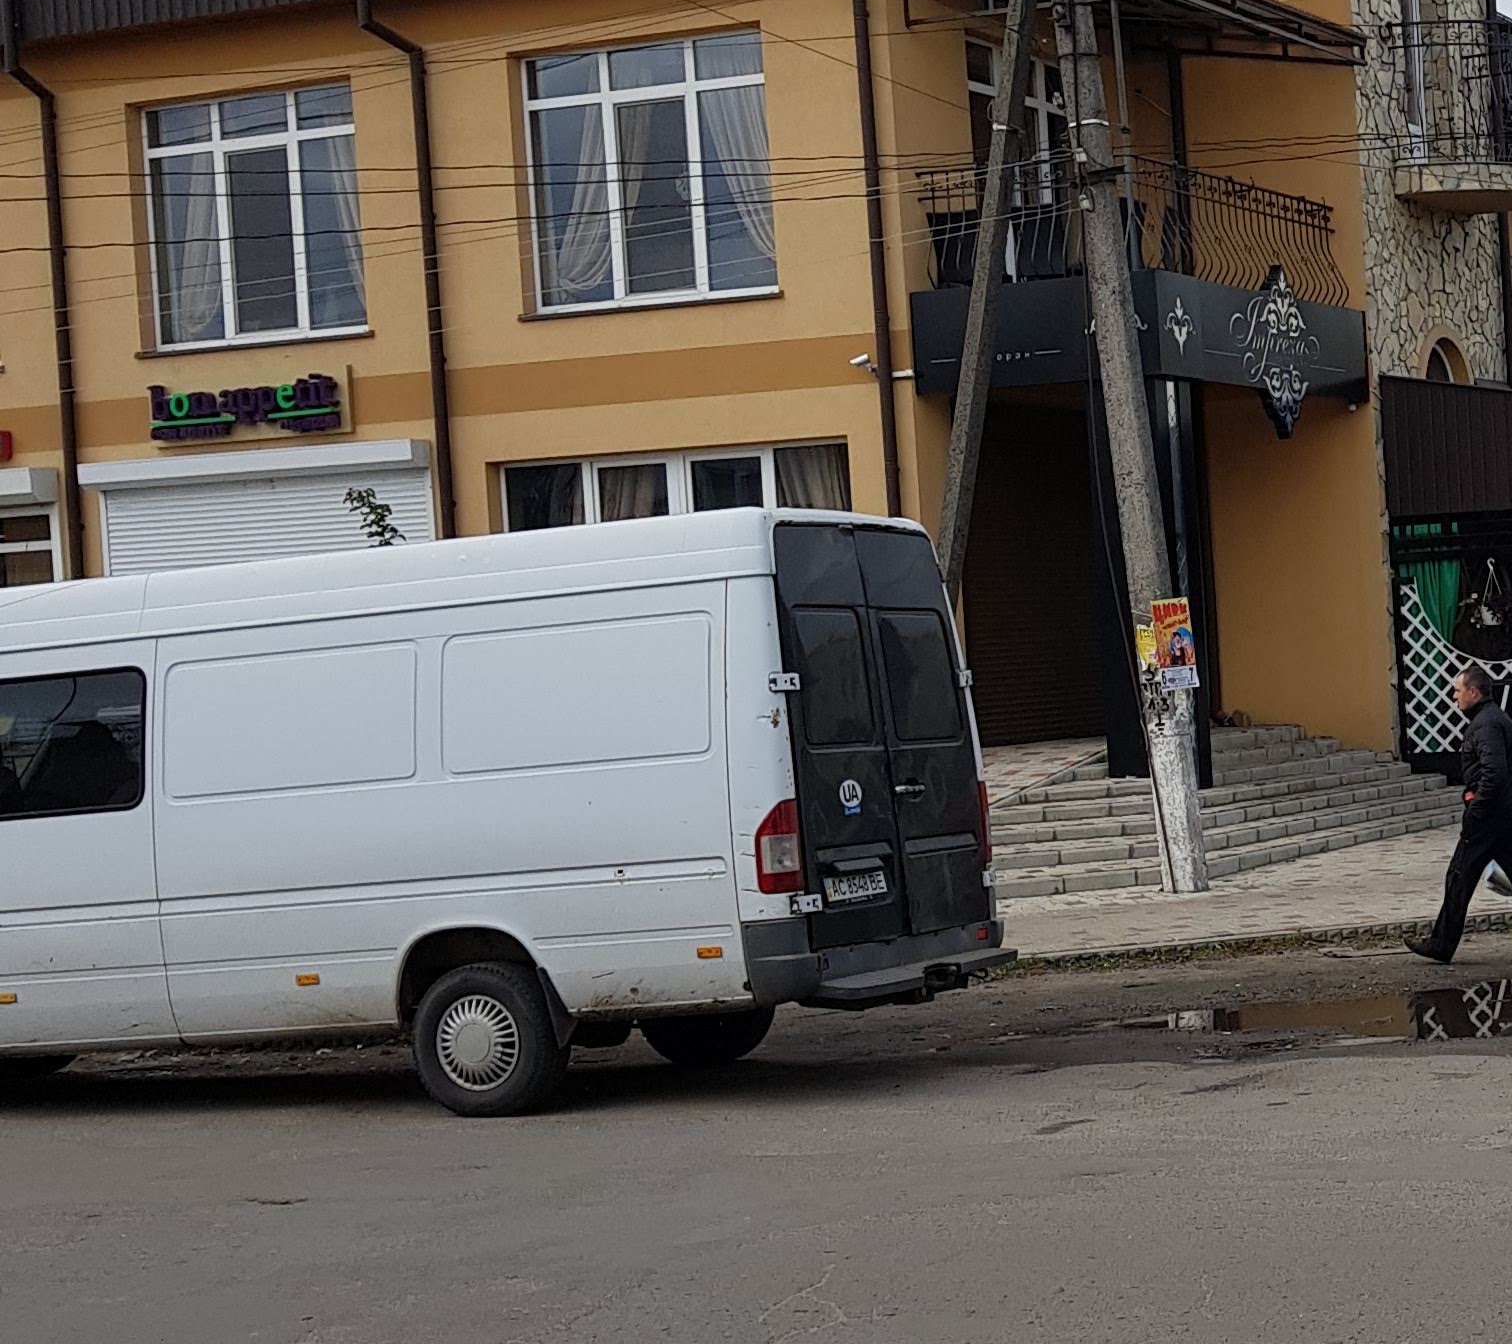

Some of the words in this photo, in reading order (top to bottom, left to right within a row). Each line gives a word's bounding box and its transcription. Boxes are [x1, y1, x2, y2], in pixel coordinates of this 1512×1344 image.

[147, 385, 221, 421] bon
[218, 373, 341, 425] appetit
[1161, 670, 1168, 686] 6
[1188, 667, 1194, 682] 7
[842, 783, 860, 804] UA
[832, 878, 847, 897] AC
[868, 872, 885, 892] BE
